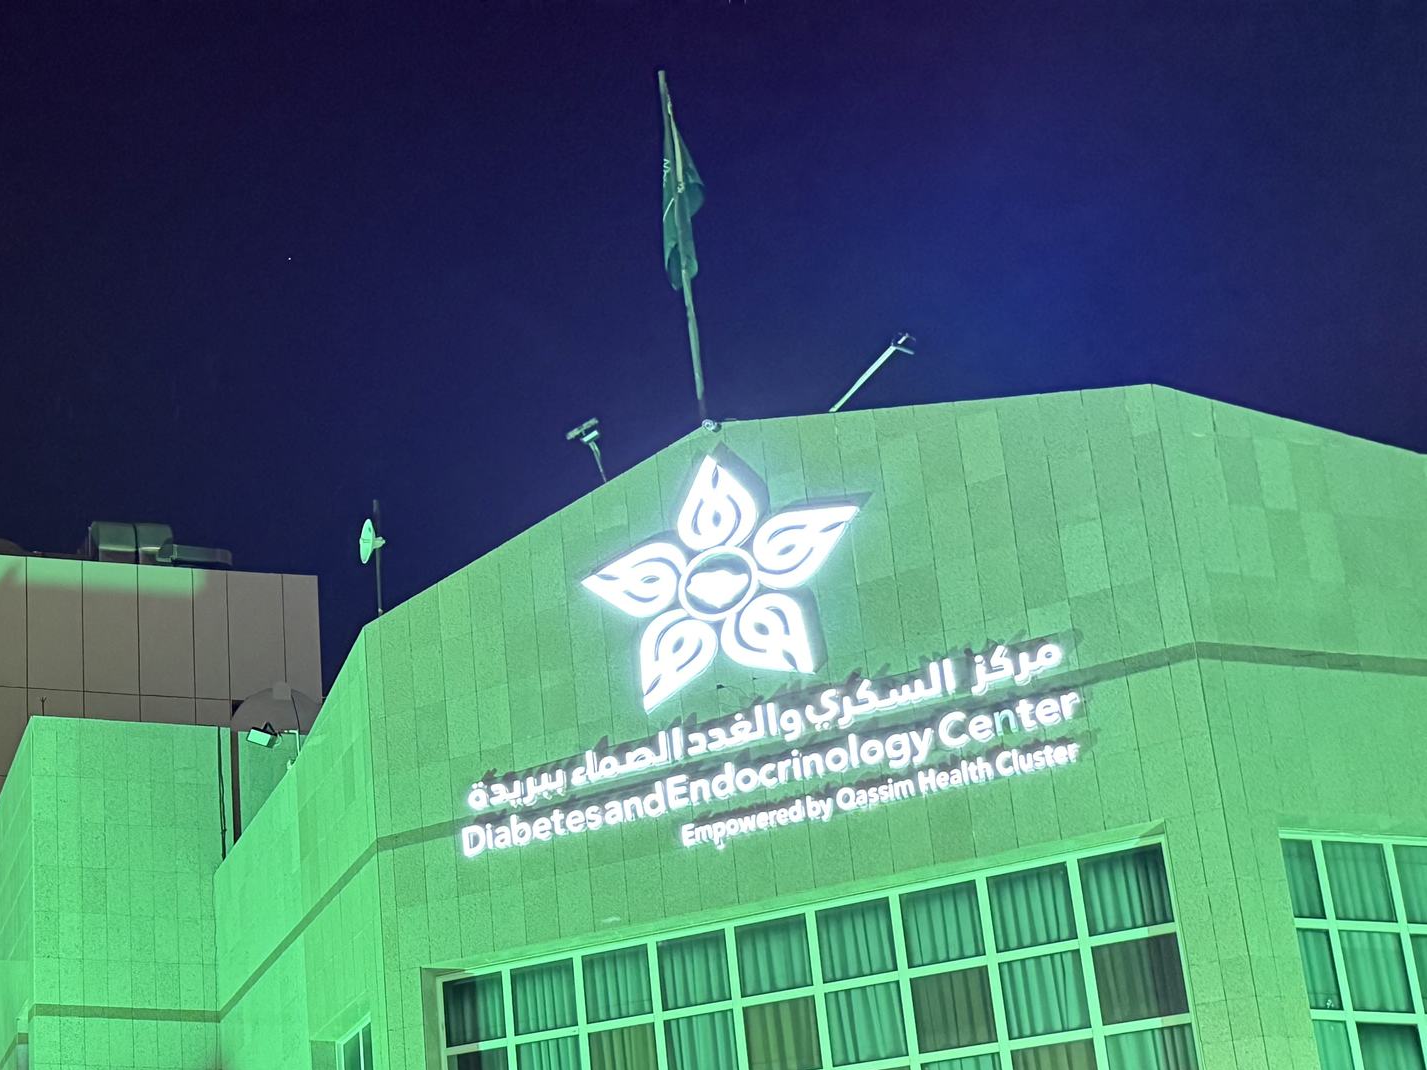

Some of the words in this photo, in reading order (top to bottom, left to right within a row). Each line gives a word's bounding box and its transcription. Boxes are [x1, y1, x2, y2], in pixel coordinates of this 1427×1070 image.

[804, 658, 957, 731] السكري
[972, 645, 1064, 696] مركز
[461, 792, 603, 858] Diabetes
[603, 779, 669, 822] and
[666, 727, 934, 811] Endocrinology
[938, 690, 1081, 750] Center
[681, 798, 804, 849] Empowered
[804, 795, 834, 822] by
[835, 777, 916, 812] Qassim
[917, 756, 994, 795] Health
[996, 741, 1080, 778] Cluster
